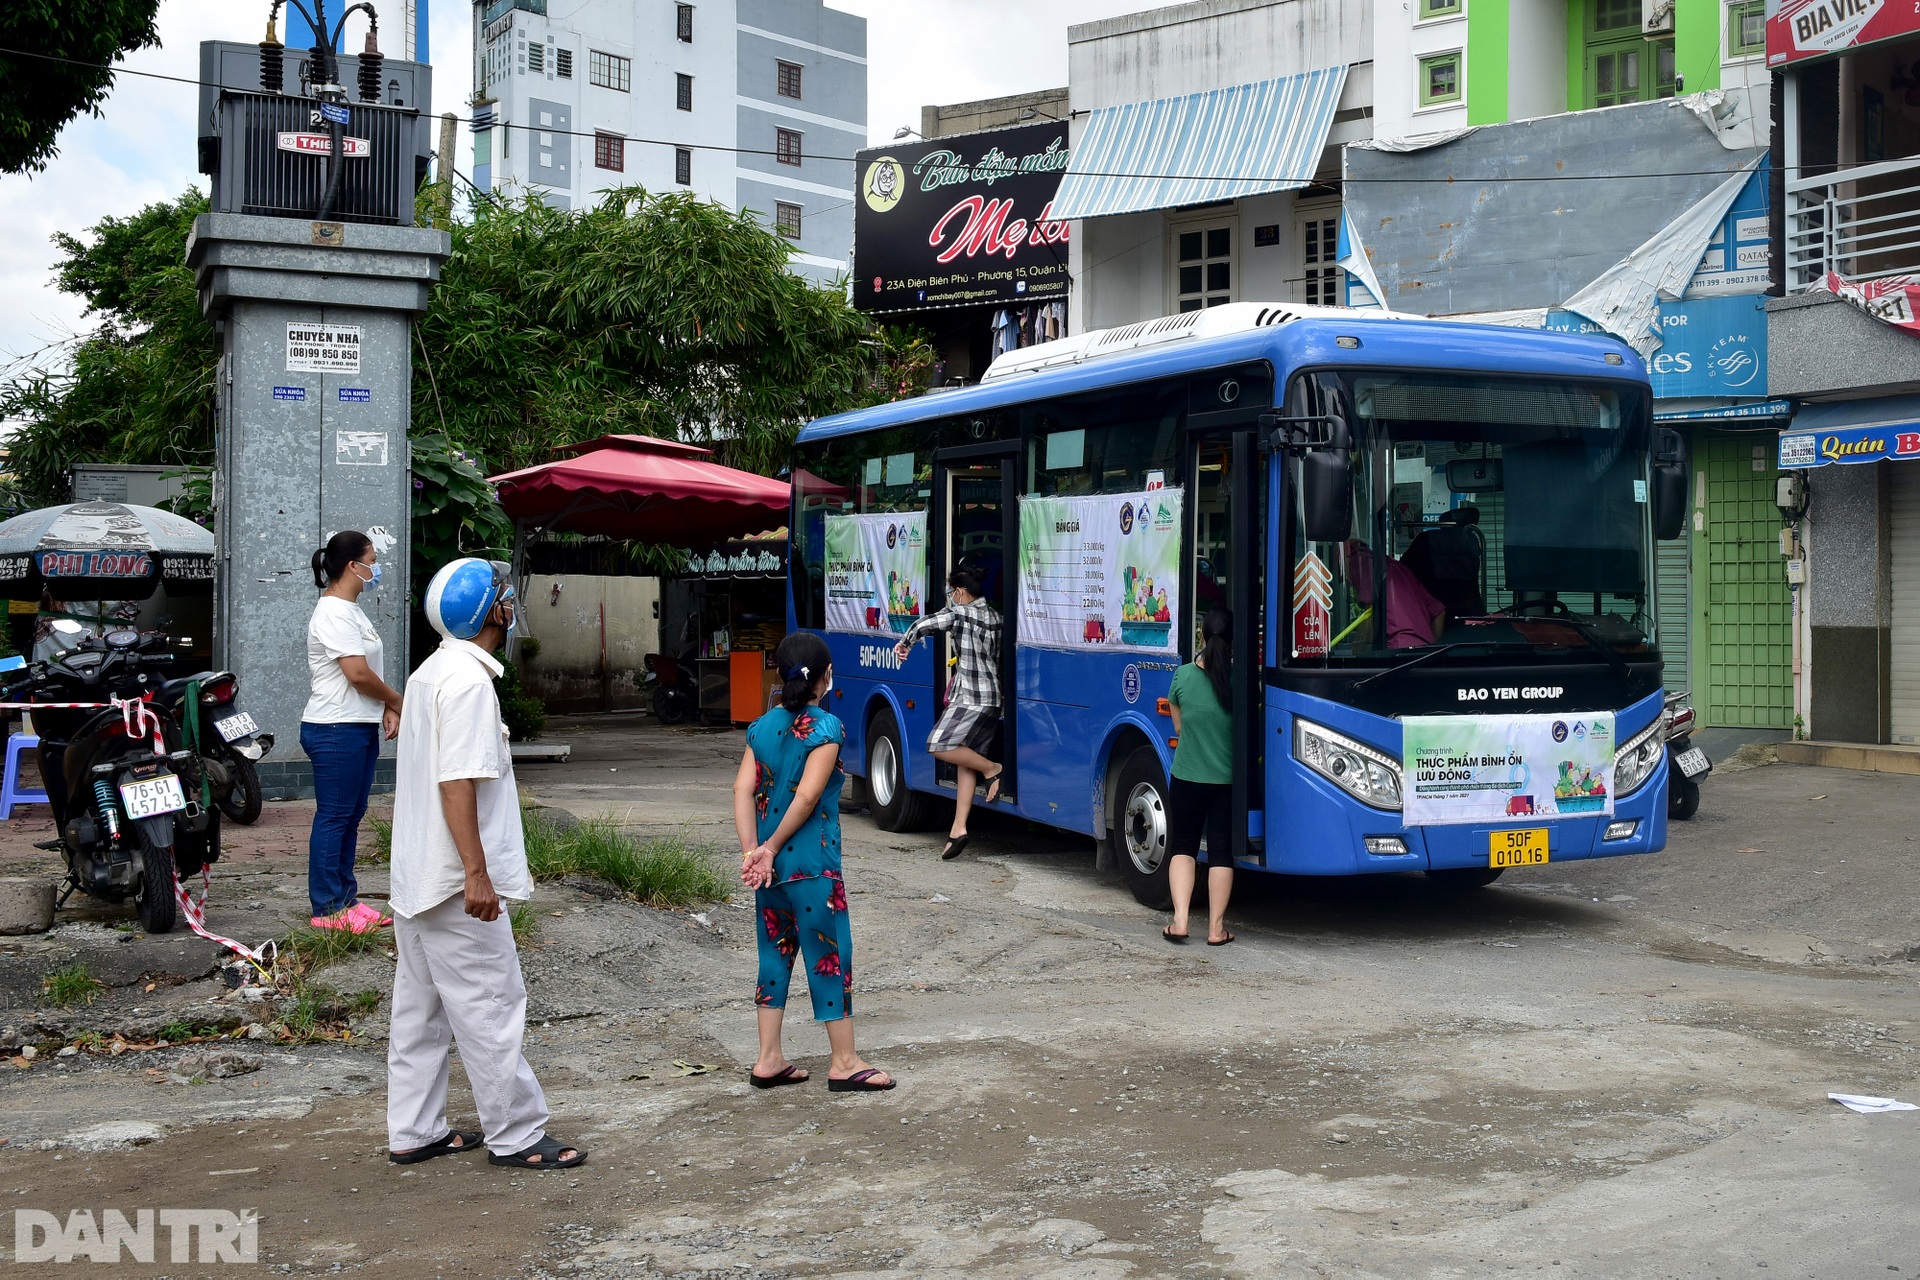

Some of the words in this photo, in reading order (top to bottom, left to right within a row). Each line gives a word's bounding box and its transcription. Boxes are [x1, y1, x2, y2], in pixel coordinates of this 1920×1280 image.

[1795, 4, 1833, 43] BIA
[913, 149, 970, 192] Bún
[972, 147, 1017, 186] đậu
[929, 195, 1027, 265] Mẹ
[1738, 252, 1769, 262] QATAR
[887, 280, 905, 290] 23A
[907, 278, 928, 289] Điện
[929, 276, 949, 286] Biên
[951, 273, 969, 284] Phủ
[977, 269, 1013, 282] Phường
[1015, 267, 1028, 278] 15,
[1029, 264, 1056, 277] Quận
[1706, 279, 1720, 287] 399
[1726, 276, 1745, 285] 0902
[1663, 315, 1688, 327] FOR
[289, 328, 333, 343] CHUYỂN
[336, 331, 359, 344] NHÀ
[290, 347, 320, 359] (08)99
[322, 349, 339, 359] 850
[341, 350, 358, 360] 850
[1752, 407, 1766, 415] 111
[1770, 405, 1786, 414] 399
[1821, 436, 1886, 460] Quán
[41, 552, 84, 576] PHI
[89, 554, 150, 576] LONG
[1303, 613, 1320, 626] CỬA
[1304, 628, 1320, 640] LÊN
[1297, 644, 1328, 654] Entrance
[1457, 688, 1489, 701] BAO
[1492, 687, 1518, 699] YEN
[1521, 687, 1564, 699] GROUP
[220, 713, 248, 730] 59-Y3
[223, 722, 258, 740] 000.92
[1416, 746, 1438, 756] Chương
[1438, 746, 1454, 755] trình
[1680, 750, 1700, 765] 59-P1
[1416, 757, 1447, 771] THỰC
[1449, 752, 1479, 768] PHẨM
[1481, 753, 1505, 767] BÌNH
[1508, 750, 1522, 766] ỔN
[1416, 770, 1436, 782] LƯU
[1438, 769, 1472, 784] ĐỘNG
[130, 779, 171, 800] 76-G1
[131, 793, 182, 816] 457.43
[1507, 832, 1531, 847] 50F
[1496, 848, 1543, 866] 010.16
